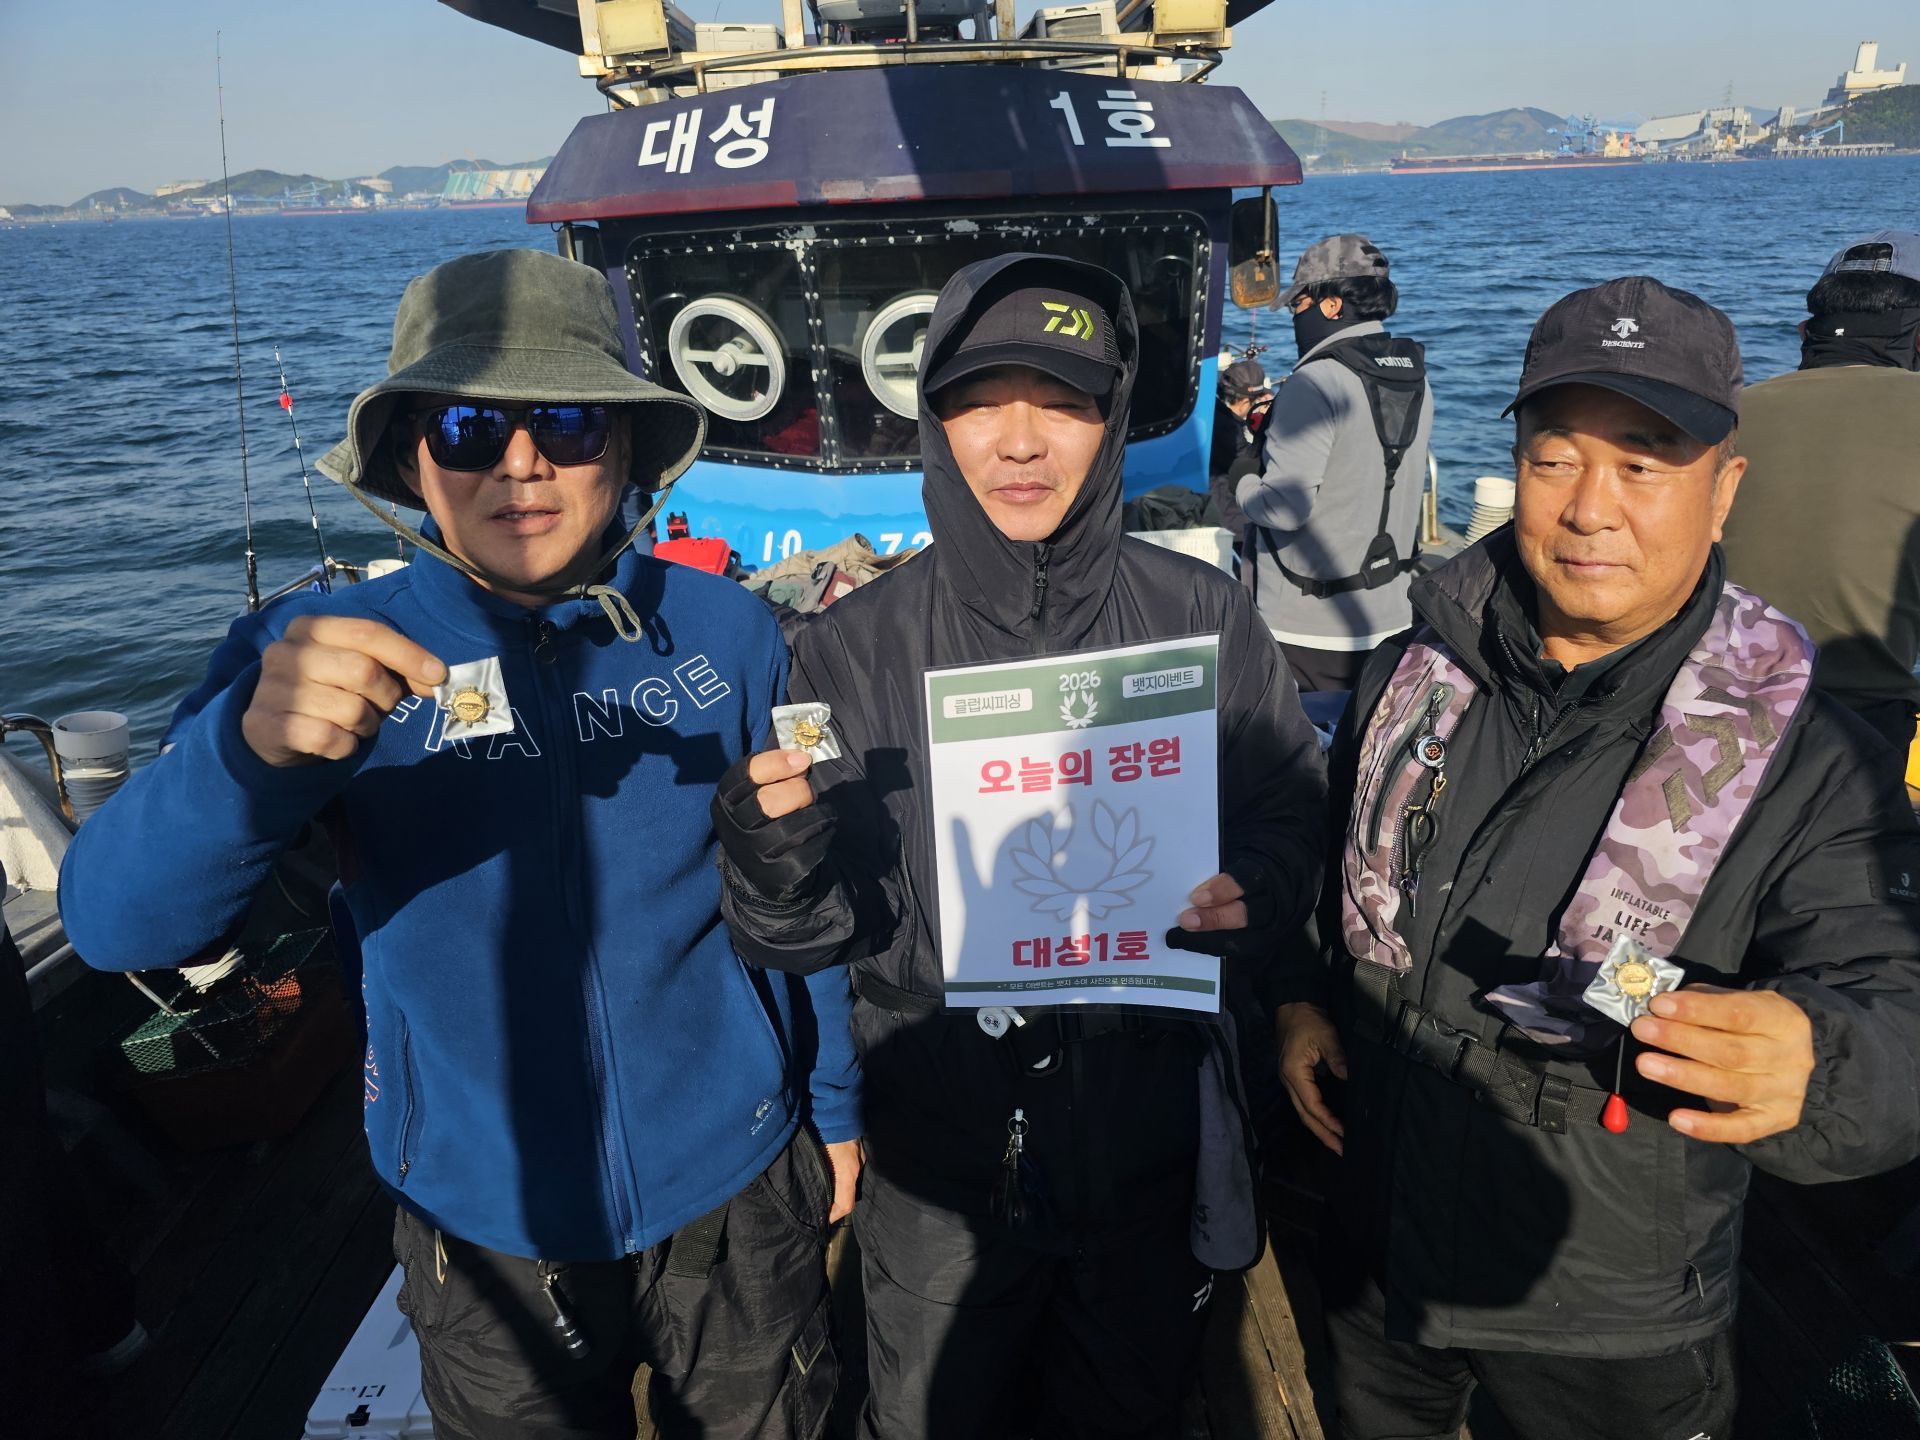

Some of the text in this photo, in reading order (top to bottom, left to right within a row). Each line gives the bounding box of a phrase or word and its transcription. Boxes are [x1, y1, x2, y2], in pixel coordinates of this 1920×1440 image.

[637, 90, 1172, 175] 대성 1호
[1601, 340, 1645, 349] DESCENTE
[1374, 356, 1414, 368] PONTUS
[1058, 671, 1101, 693] 2026
[1132, 670, 1195, 693] 뱃지이벤트
[954, 693, 1021, 714] 클럽씨피싱
[978, 736, 1181, 794] 오늘의 장원
[1610, 887, 1671, 920] INFLATABLE
[1614, 910, 1651, 937] LIFE
[1012, 930, 1151, 969] 대성1호
[1090, 977, 1118, 985] 사진으로
